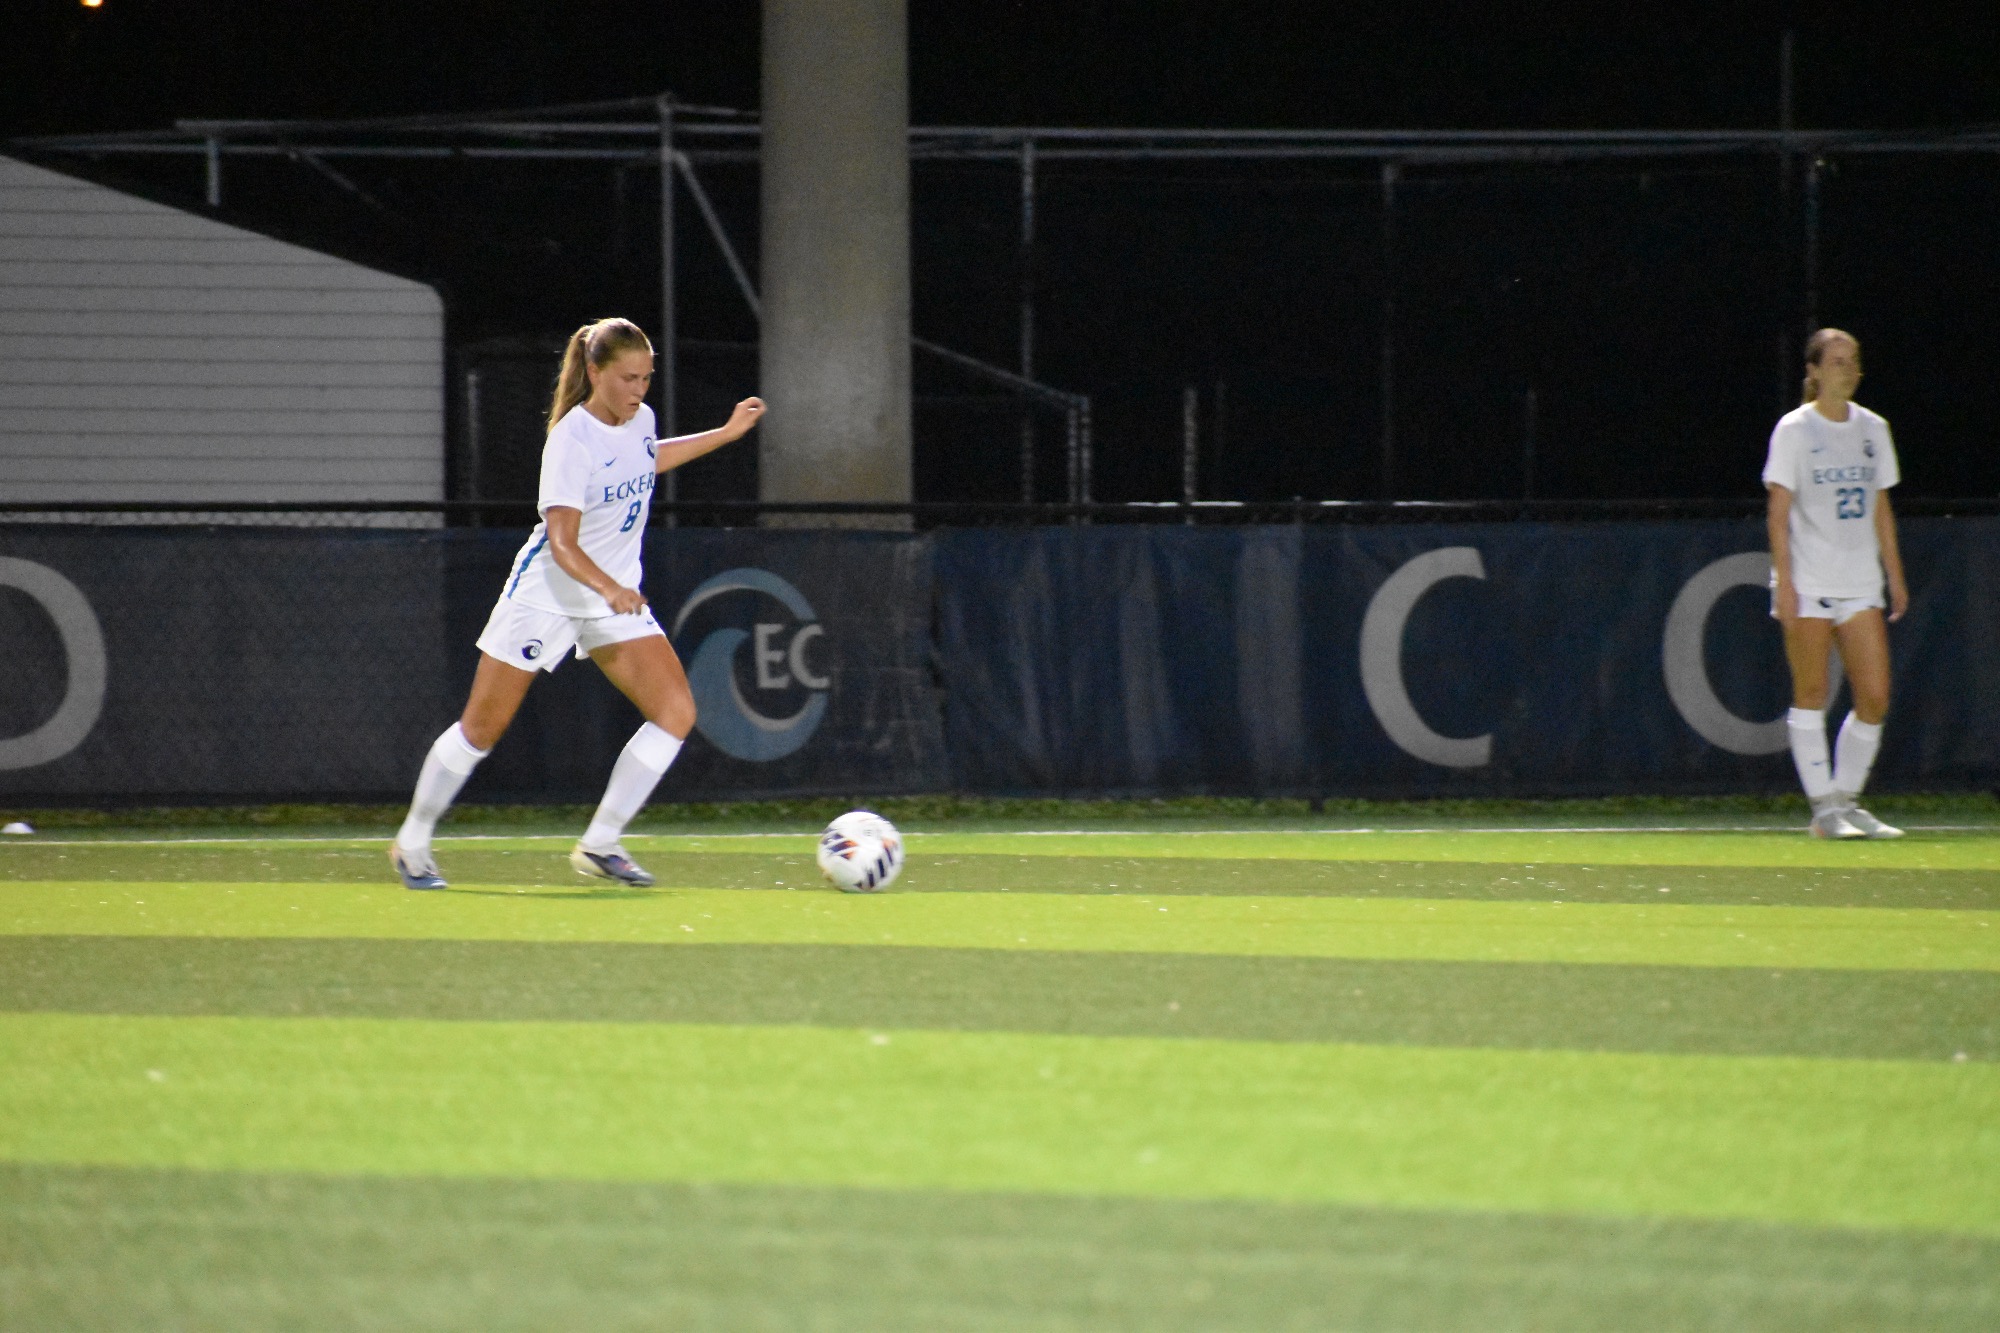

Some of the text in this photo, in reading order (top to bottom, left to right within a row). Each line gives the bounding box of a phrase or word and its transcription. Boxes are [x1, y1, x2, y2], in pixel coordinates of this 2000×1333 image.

[619, 499, 642, 532] 8
[1836, 487, 1865, 519] 23
[754, 623, 830, 689] EC
